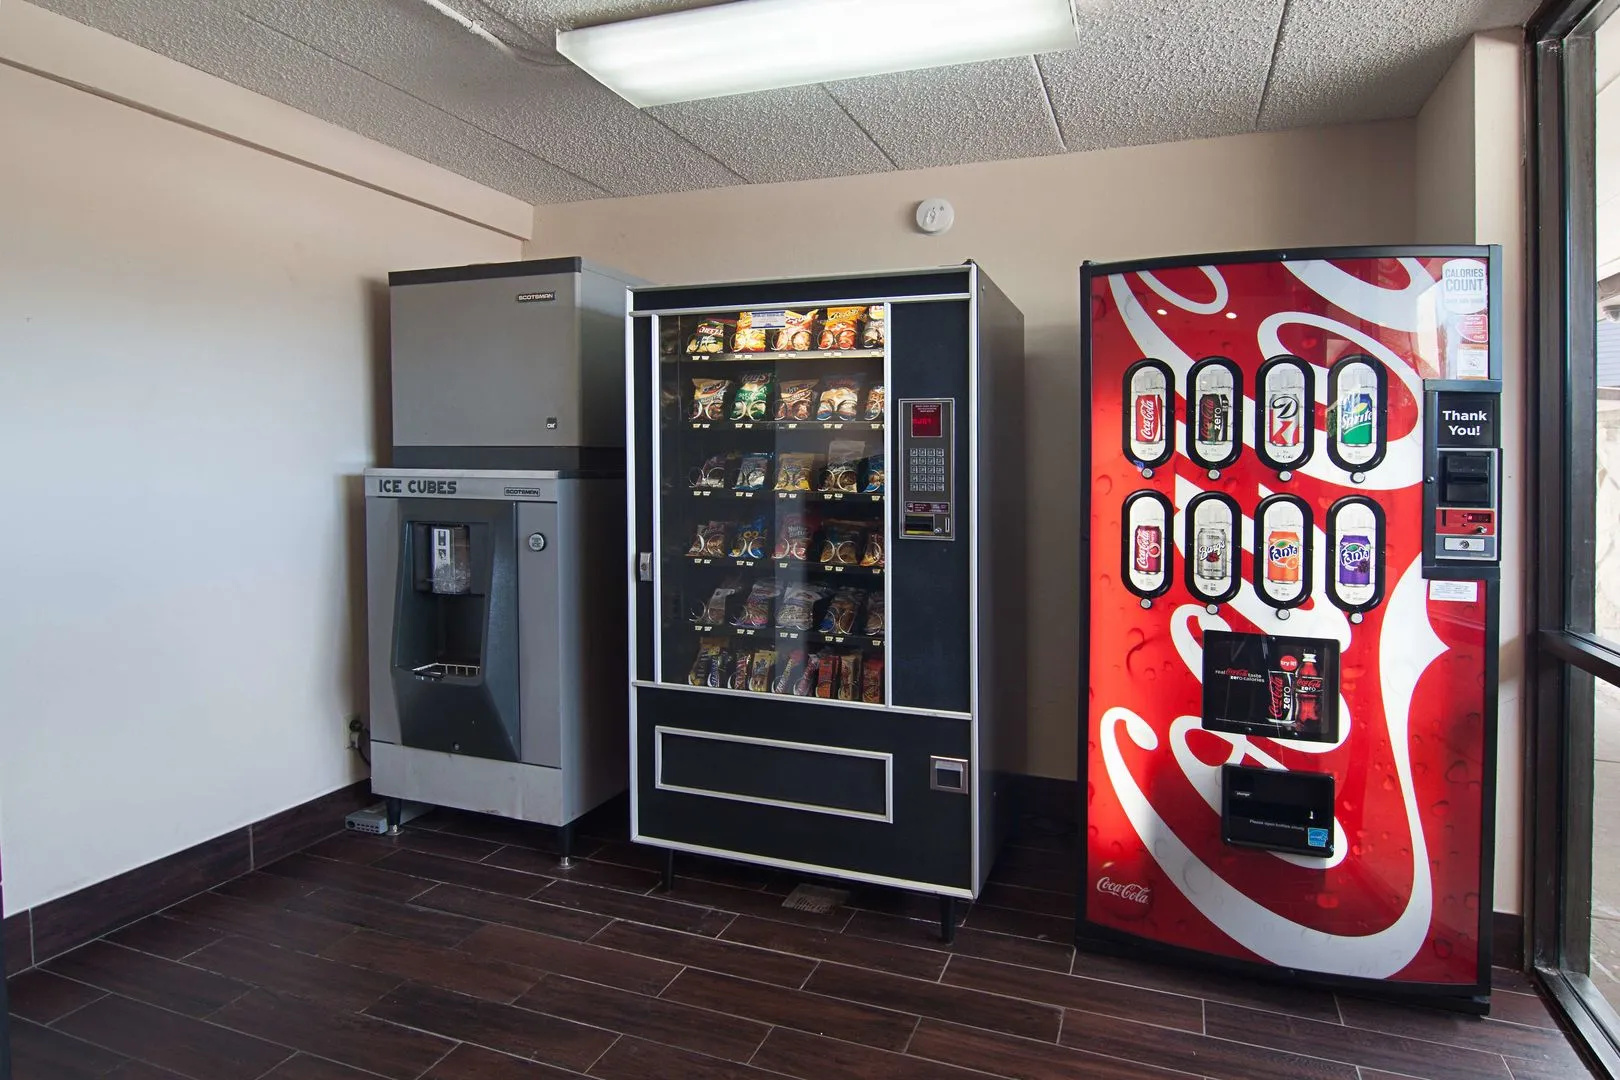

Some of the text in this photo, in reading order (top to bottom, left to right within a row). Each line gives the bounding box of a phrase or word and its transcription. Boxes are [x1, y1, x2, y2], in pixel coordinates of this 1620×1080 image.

[1445, 268, 1484, 278] CALORIES
[1445, 279, 1484, 291] COUNT
[518, 292, 554, 301] SCOTSMAN
[1140, 399, 1154, 439] Coca-Cola
[1342, 410, 1372, 429] Sprite
[1442, 410, 1487, 421] Thank
[1448, 425, 1480, 436] You!
[379, 479, 457, 495] ICE CUBES
[1136, 528, 1150, 568] Coca-Cola
[1269, 544, 1298, 562] Fanta
[1340, 547, 1370, 566] Fanta
[1269, 676, 1283, 718] Coca-Cola
[1283, 686, 1291, 710] zero
[1096, 876, 1151, 904] Coca-Cola
